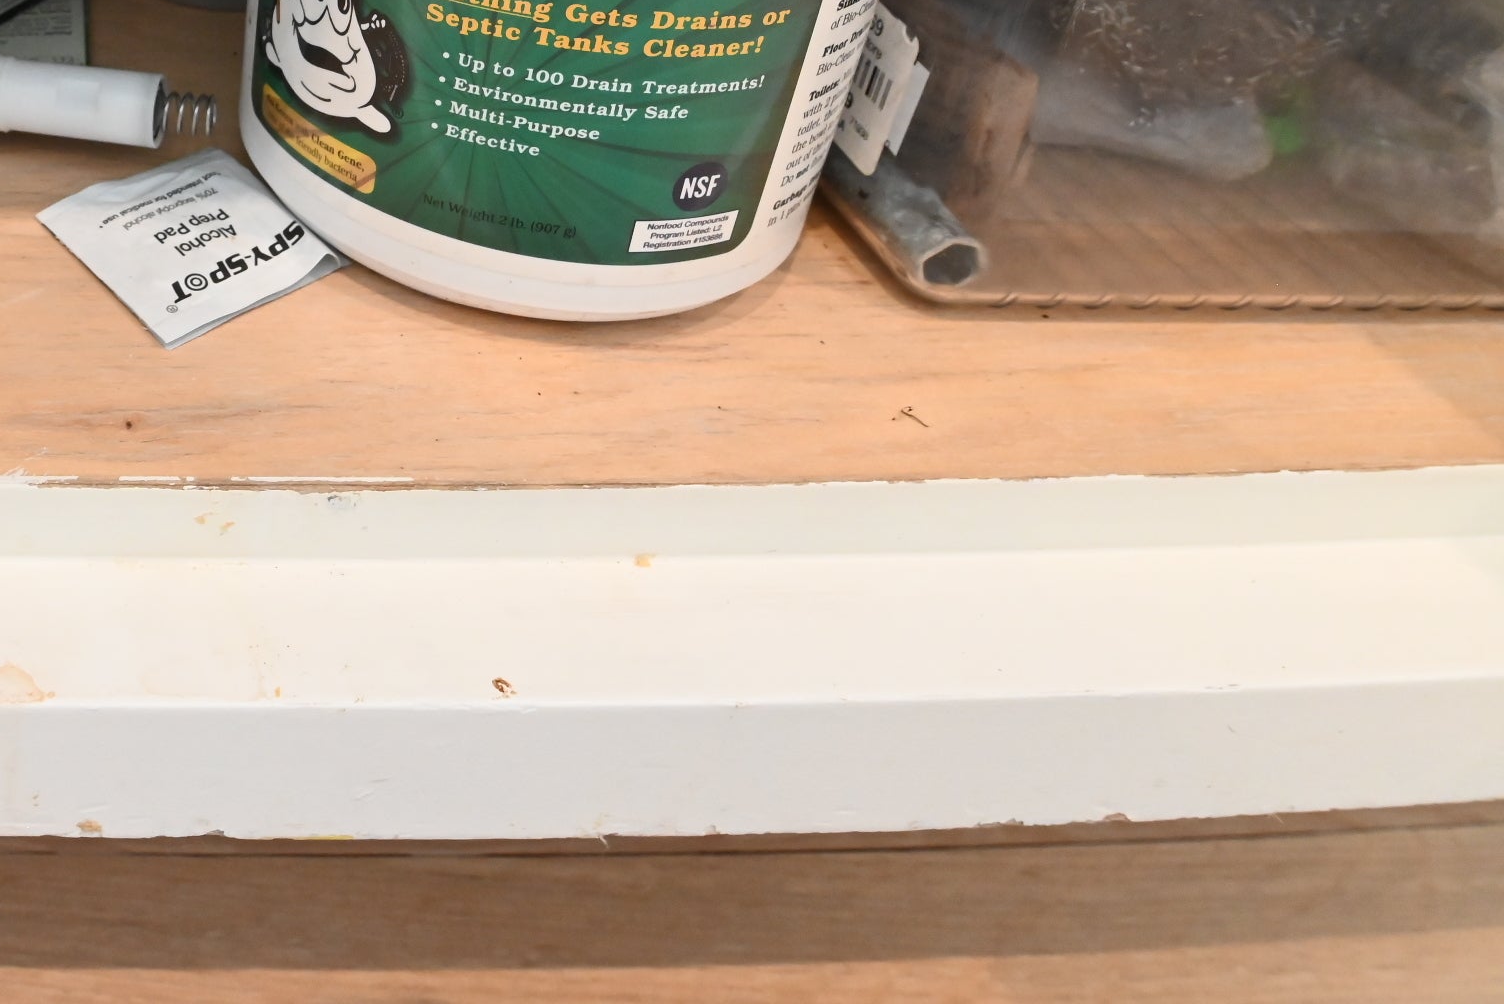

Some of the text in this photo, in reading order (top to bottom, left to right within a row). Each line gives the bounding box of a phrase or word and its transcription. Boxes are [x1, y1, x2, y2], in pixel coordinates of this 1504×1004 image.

[426, 4, 765, 58] Septic Tanks Cleaner!
[565, 4, 638, 28] Gets
[650, 11, 752, 30] Drains
[762, 9, 791, 26] or
[458, 54, 766, 95] Up to 100 Drain Treatments!
[453, 78, 689, 121] Environmentally Safe
[449, 101, 601, 140] Multi-Purpose
[311, 133, 365, 172] Clean Gene,
[445, 124, 540, 156] Effective
[324, 157, 357, 182] bacteria
[680, 175, 720, 199] NSF
[154, 208, 229, 244] Prep Pad
[424, 194, 445, 211] Net
[448, 202, 496, 226] Weight
[498, 215, 508, 226] 2
[174, 224, 237, 257] Alcohol
[643, 240, 691, 249] Registration
[650, 232, 684, 240] Program
